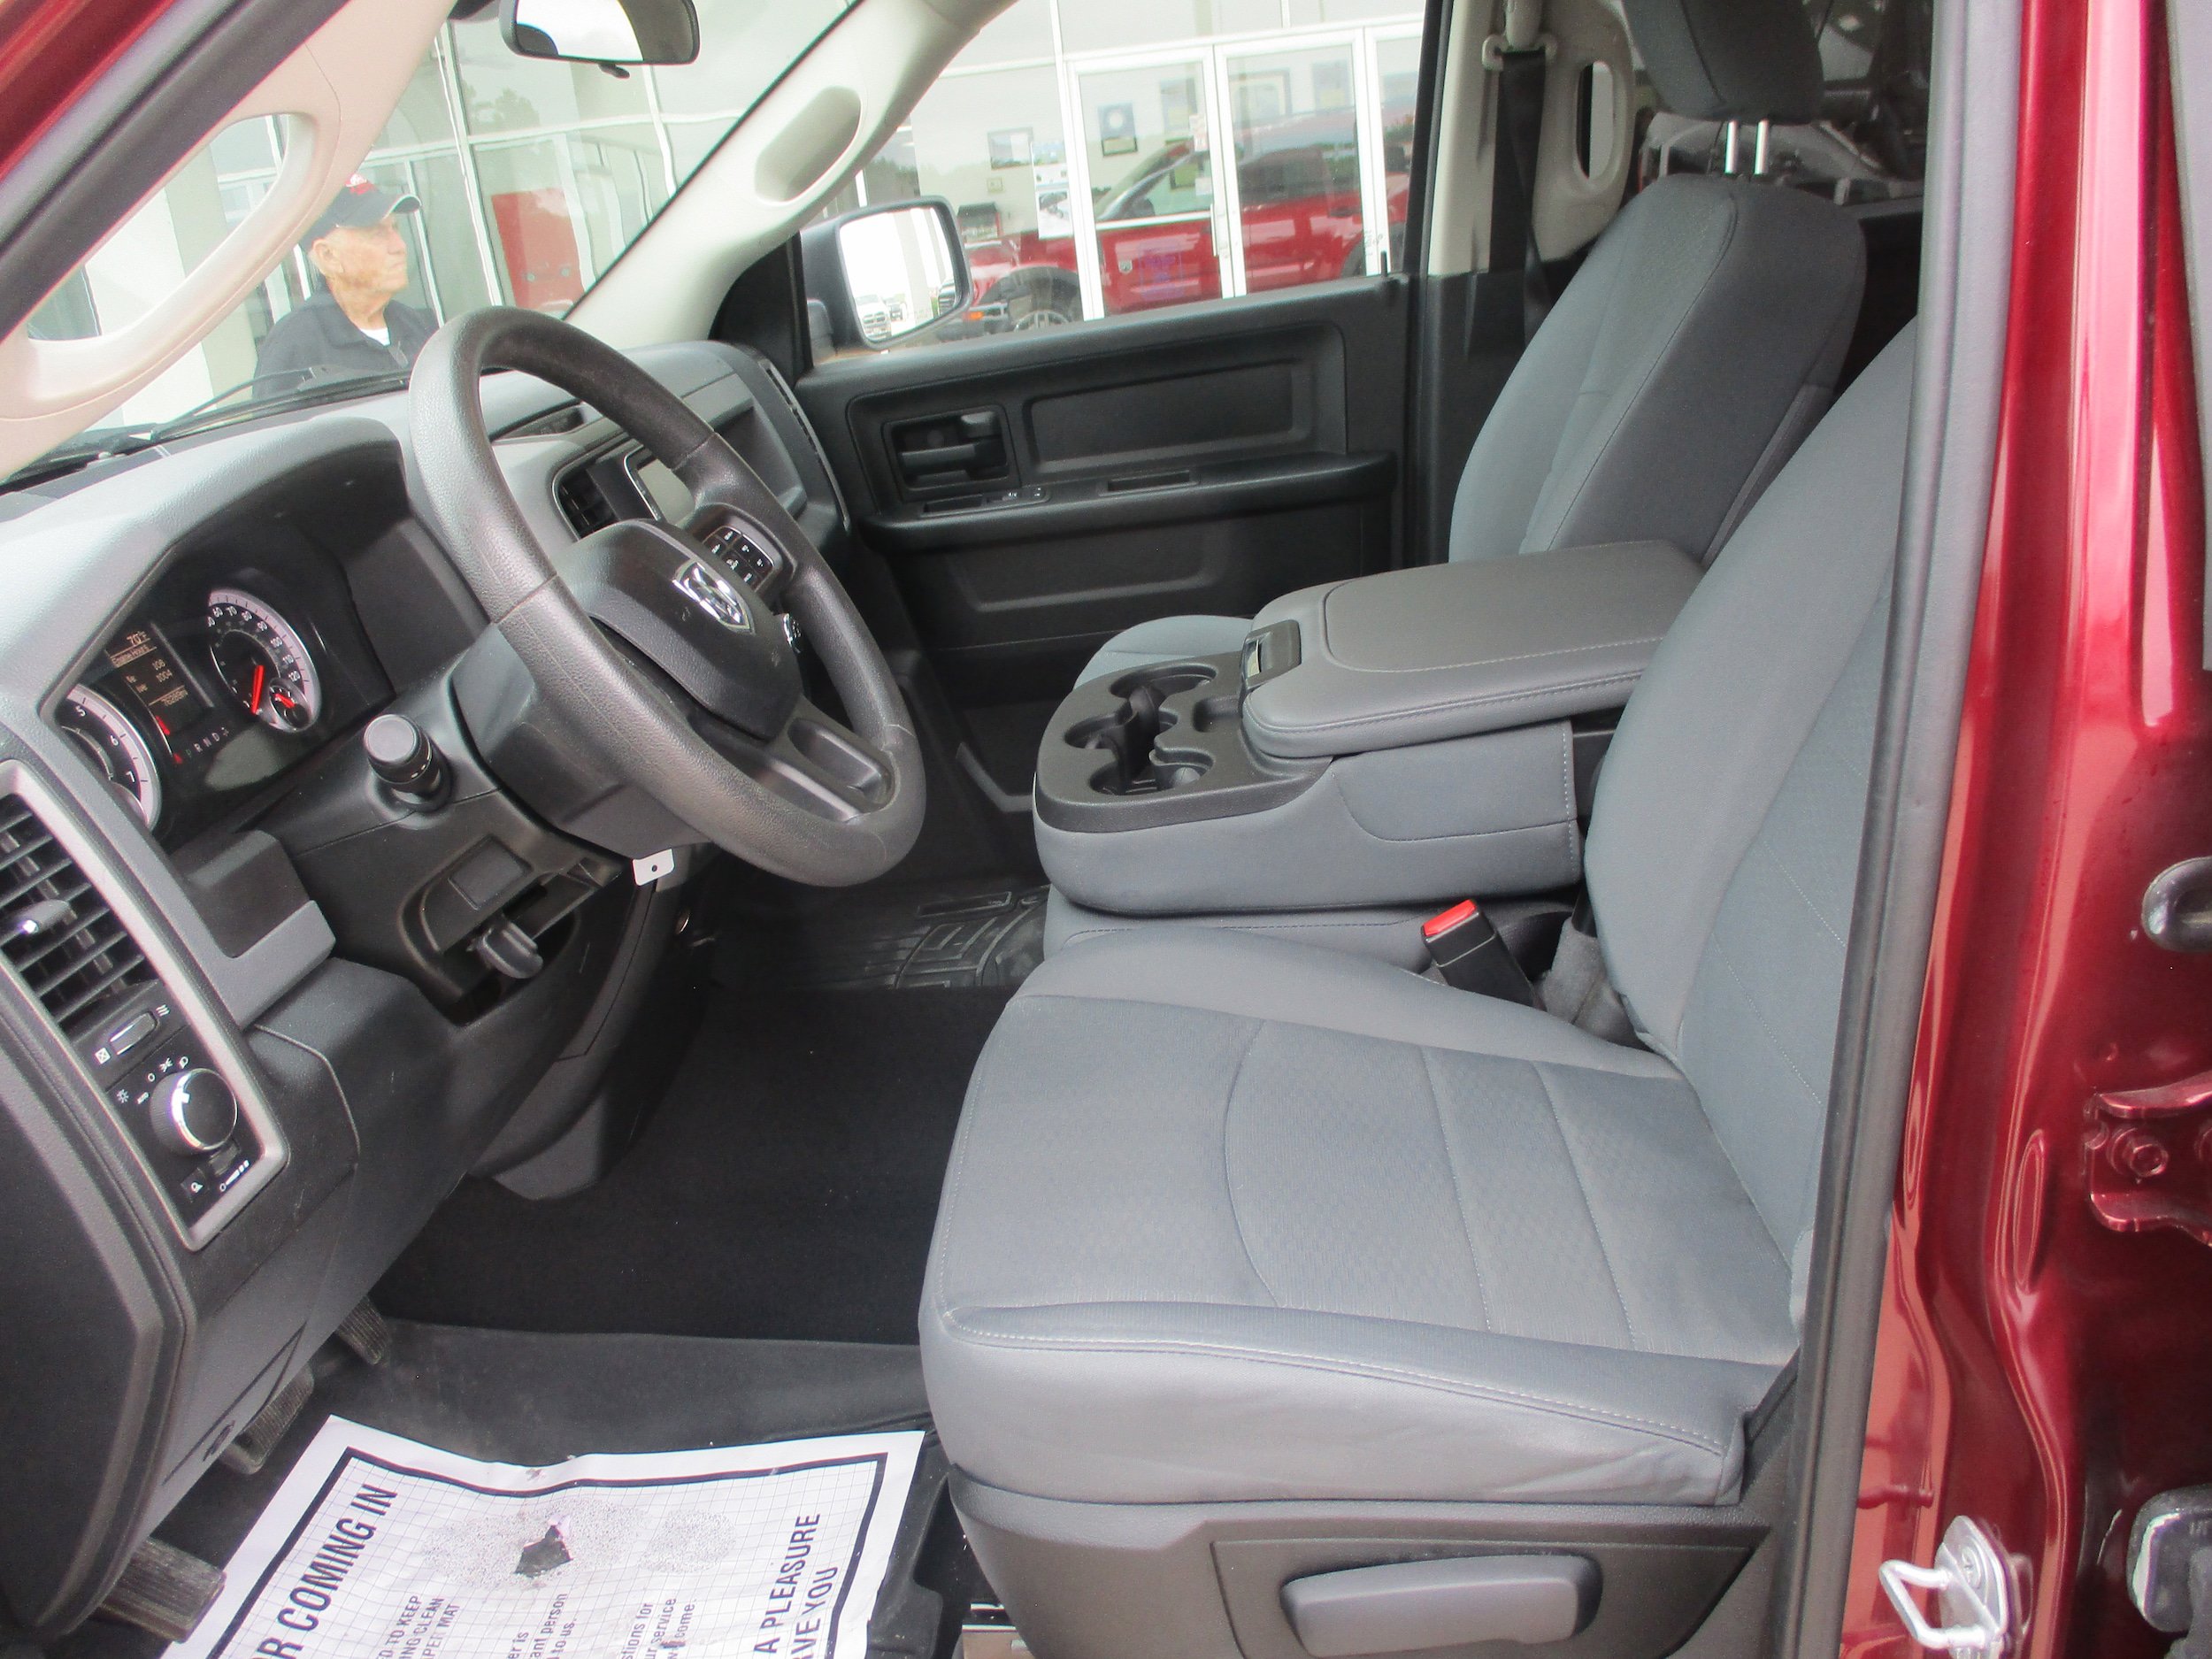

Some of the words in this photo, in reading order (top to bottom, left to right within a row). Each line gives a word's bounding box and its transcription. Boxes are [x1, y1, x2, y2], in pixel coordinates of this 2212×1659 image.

[226, 606, 238, 617] 70
[270, 636, 283, 648] 100
[282, 654, 294, 664] 110
[288, 670, 301, 681] 120
[75, 705, 86, 717] 5
[110, 735, 119, 746] 6
[211, 732, 220, 742] D
[126, 771, 135, 782] 7
[350, 1483, 398, 1516] IN
[277, 1517, 377, 1632] COMING
[760, 1514, 821, 1629] PLEASURE
[801, 1567, 838, 1615] YOU
[385, 1630, 405, 1646] TO
[396, 1595, 421, 1626] KEEP
[413, 1598, 445, 1634] CLEAN
[436, 1603, 460, 1627] MAT
[540, 1594, 568, 1634] person
[635, 1603, 653, 1619] for
[650, 1598, 677, 1644] service
[512, 1632, 529, 1643] is
[551, 1640, 566, 1654] to
[560, 1618, 577, 1637] us.
[753, 1637, 780, 1653] A
[252, 1637, 304, 1659] R
